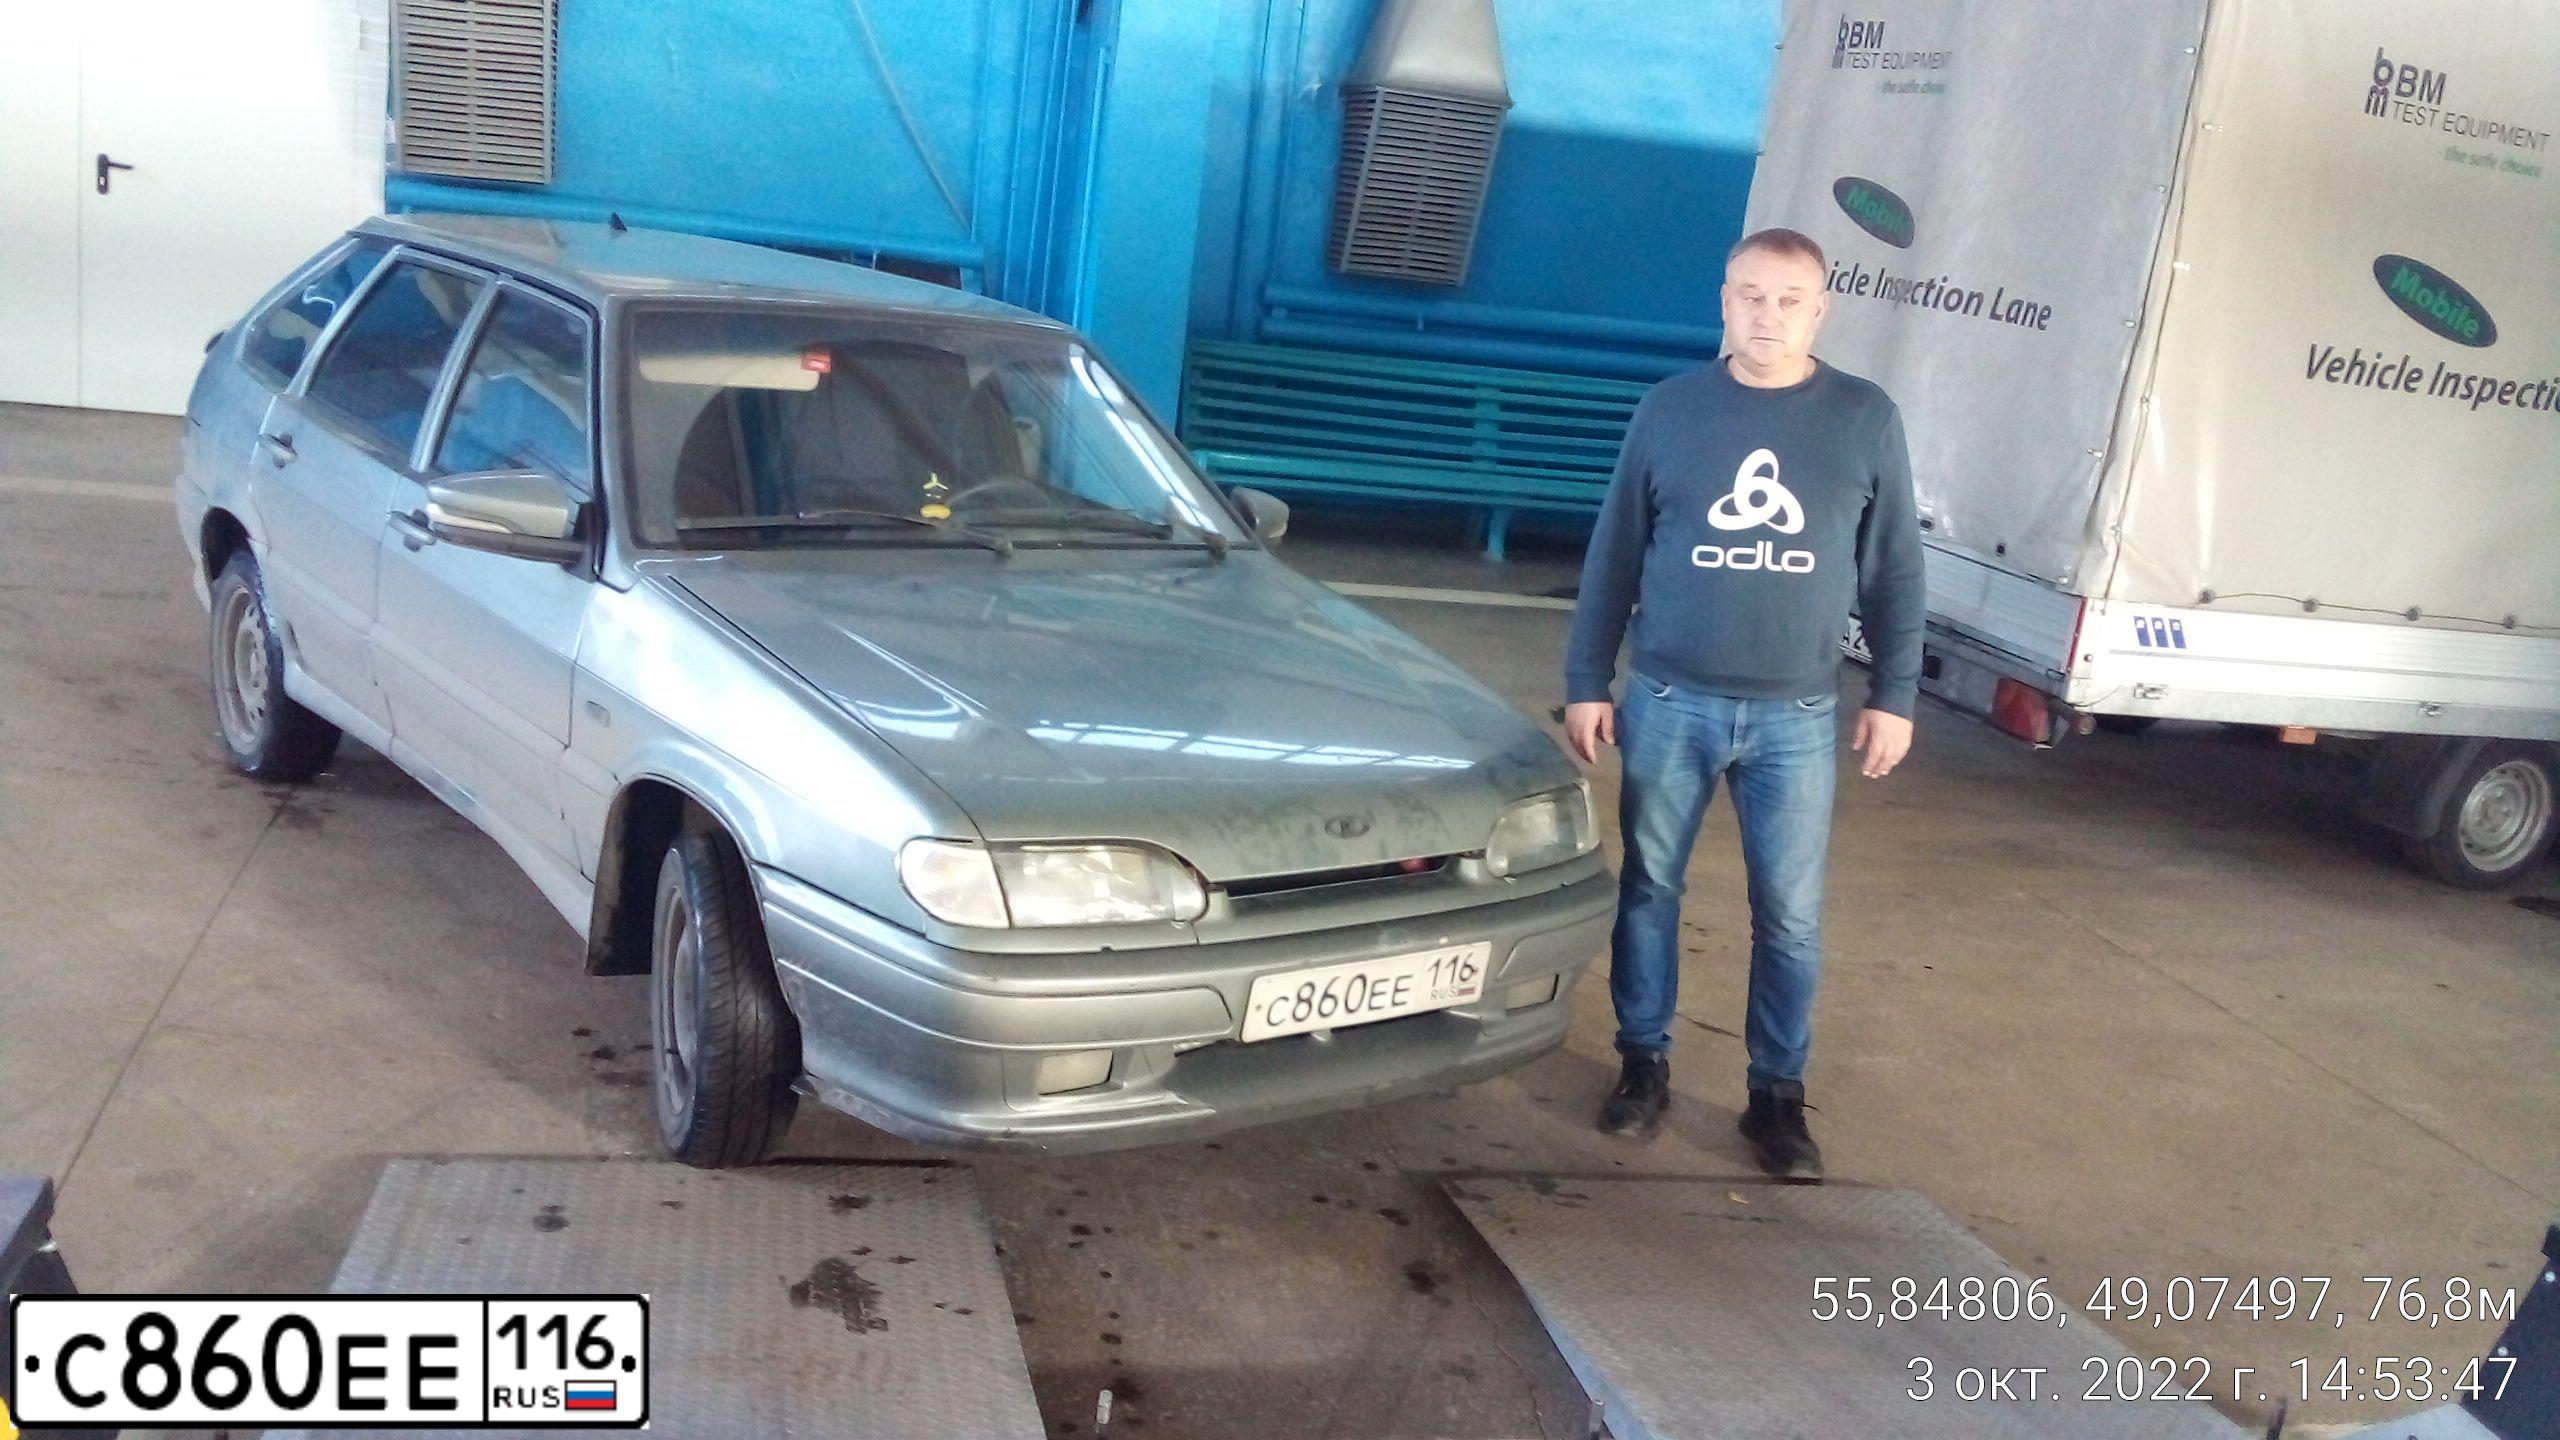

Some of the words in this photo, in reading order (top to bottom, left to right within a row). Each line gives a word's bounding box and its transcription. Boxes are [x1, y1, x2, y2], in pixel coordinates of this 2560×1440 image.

[1846, 50, 1881, 69] TEST
[2392, 99, 2440, 128] TEST
[2442, 111, 2552, 153] EQUIPMENT
[1826, 260, 1871, 297] icle
[1987, 286, 2052, 331] Lane
[2391, 266, 2480, 339] Mobile
[2306, 343, 2424, 393] Vehicle
[1691, 540, 1815, 573] odlo
[1427, 953, 1475, 986] 116
